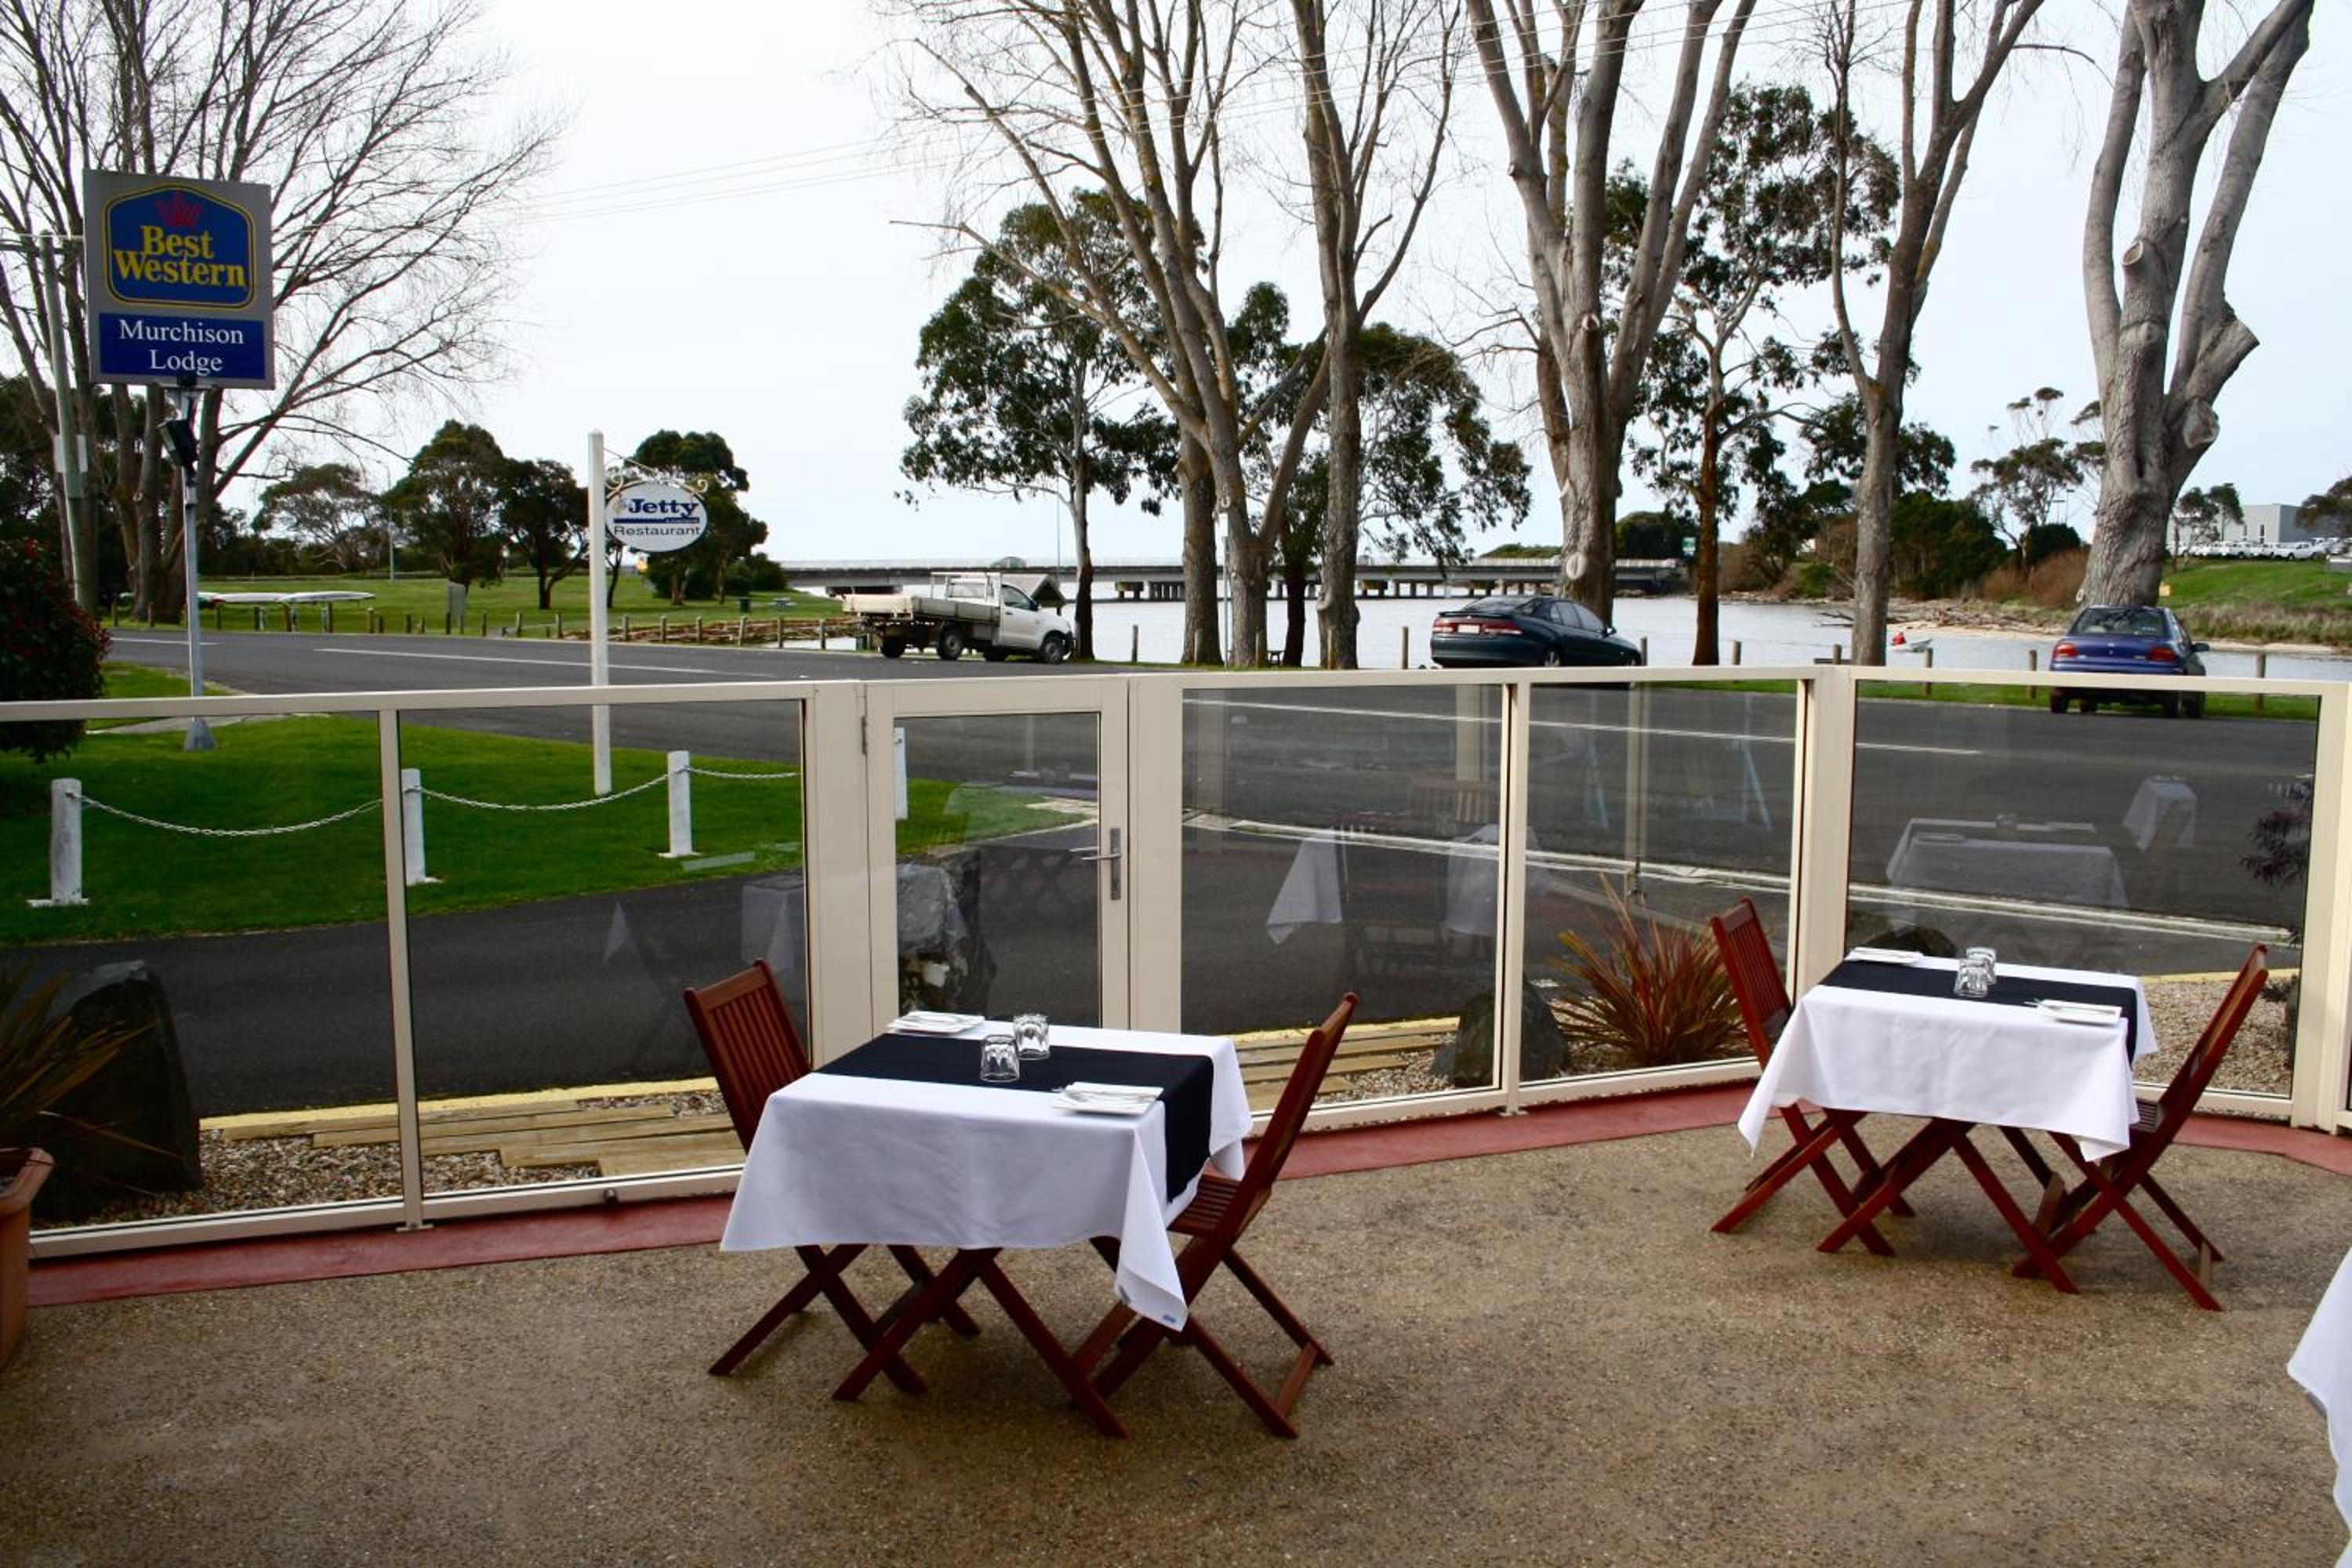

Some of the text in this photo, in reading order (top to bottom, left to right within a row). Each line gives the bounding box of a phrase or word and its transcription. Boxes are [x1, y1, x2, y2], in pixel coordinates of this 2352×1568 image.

[141, 225, 214, 259] Best
[113, 249, 246, 287] Western
[119, 319, 244, 343] Murchison
[150, 350, 223, 376] Lodge
[628, 498, 699, 517] Jetty
[613, 526, 700, 535] Restaurant
